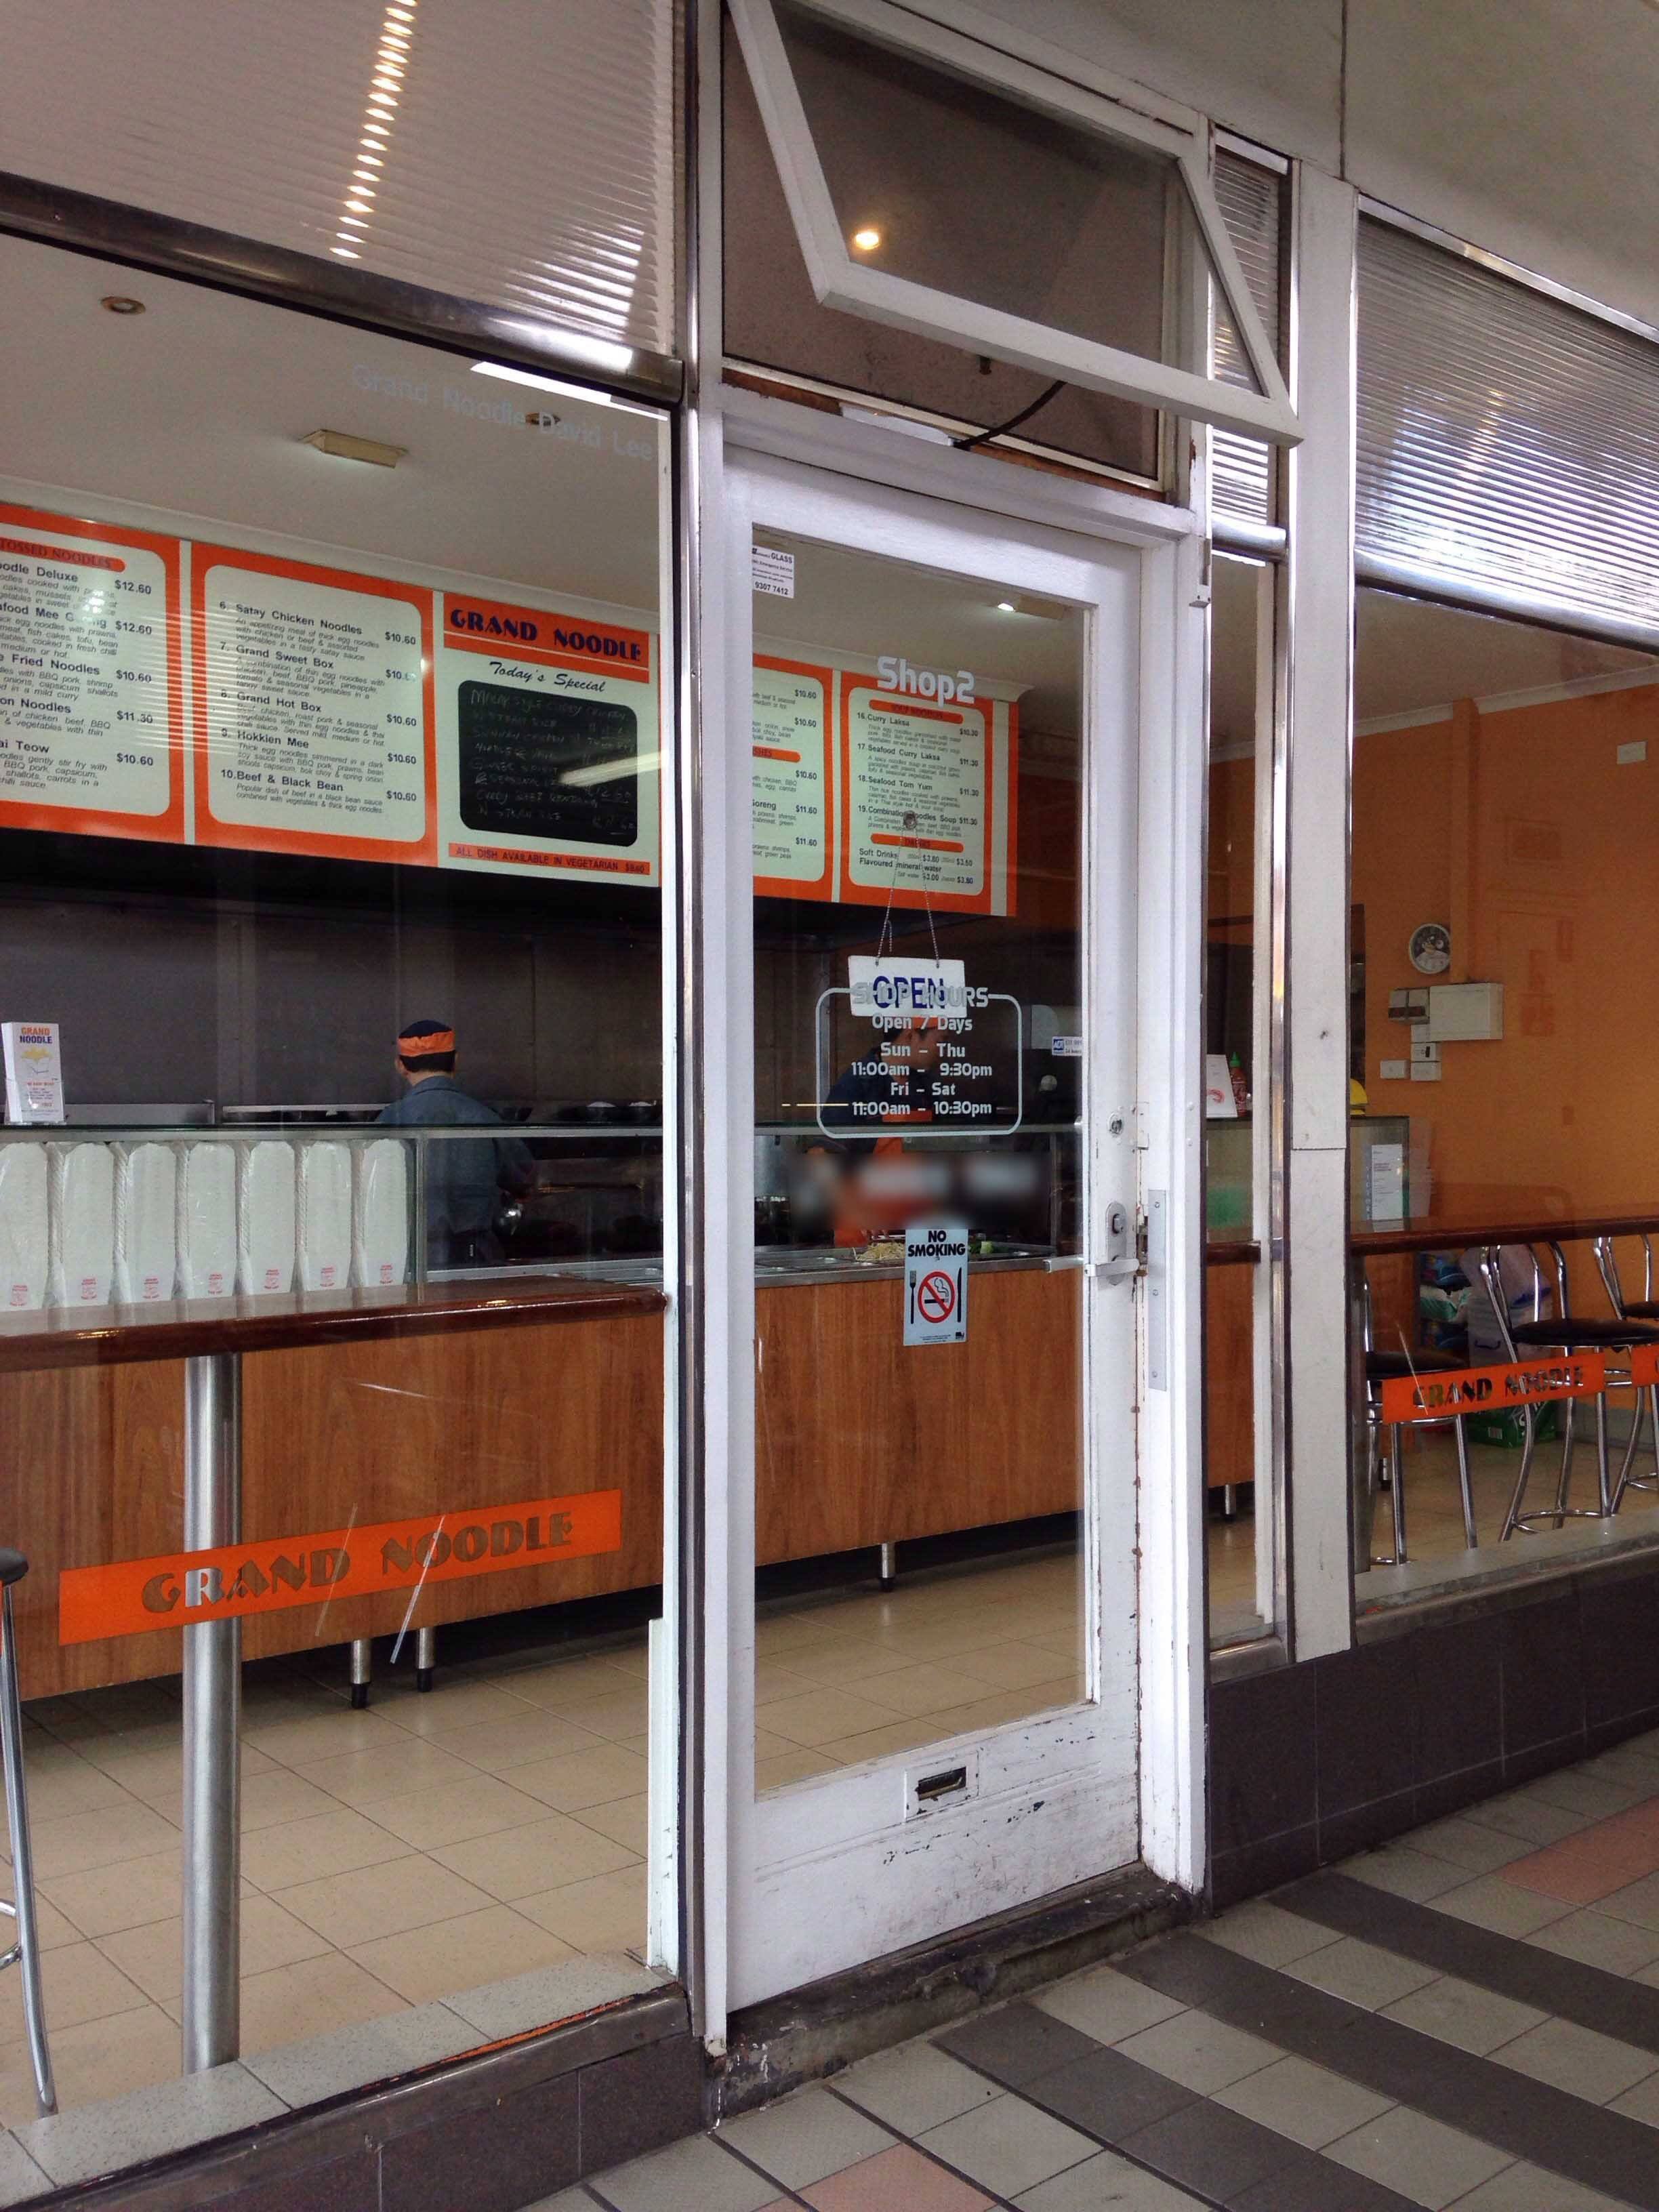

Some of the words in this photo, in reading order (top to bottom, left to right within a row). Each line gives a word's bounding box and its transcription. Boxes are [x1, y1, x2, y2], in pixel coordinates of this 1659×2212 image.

[613, 432, 653, 462] Lee
[53, 550, 111, 568] NOODLES
[37, 567, 79, 582] Deluxe
[115, 580, 152, 594] $12.60
[35, 607, 59, 619] Mee
[236, 603, 265, 619] Satay
[272, 610, 314, 626] Chicken
[321, 619, 363, 635] Noodles
[34, 622, 65, 631] noodles
[115, 621, 152, 635] $12.60
[385, 632, 416, 645] $10.60
[451, 609, 537, 642] GRAND
[554, 628, 640, 661] NOODLE
[236, 644, 269, 658] Grand
[276, 651, 307, 665] Sweet
[313, 657, 334, 669] Box
[12, 654, 43, 667] Fried
[51, 659, 101, 675] Noodles
[116, 670, 152, 683] $10.60
[489, 661, 546, 683] Today's
[554, 673, 606, 693] Special
[20, 698, 71, 714] Noodles
[237, 691, 270, 705] Grand
[276, 697, 295, 709] Hot
[301, 701, 322, 712] Box
[117, 710, 153, 724] $11.30
[386, 714, 417, 726] $10.60
[795, 717, 817, 728] $10.60
[890, 716, 910, 726] Laksa
[90, 720, 111, 730] BBQ
[237, 730, 281, 745] Hokkien
[287, 737, 309, 749] Mee
[16, 741, 49, 754] Teow
[868, 744, 895, 755] Seafood
[899, 749, 917, 759] Curry
[921, 752, 940, 761] Laksa
[117, 753, 154, 766] $10.60
[388, 753, 417, 764] $10.60
[796, 770, 817, 780] $10.60
[268, 775, 275, 784] &
[282, 777, 311, 788] Black
[316, 781, 344, 791] Bean
[918, 782, 933, 791] Yum
[386, 790, 417, 802] $10.60
[940, 815, 957, 824] Soup
[455, 846, 472, 857] ALL
[477, 848, 497, 860] DISH
[502, 851, 549, 865] AVAILABLE
[554, 856, 562, 865] IN
[567, 857, 619, 871] VEGETARIAN
[859, 848, 874, 857] Soft
[876, 850, 898, 859] Drinks
[859, 857, 893, 867] Flavoured
[896, 861, 921, 870] mineral
[924, 865, 942, 873] water
[873, 975, 945, 1008] OPEN
[922, 985, 989, 1008] HOURS
[872, 1012, 912, 1033] Open
[920, 1015, 929, 1030] 7
[937, 1015, 972, 1034] Days
[21, 1027, 50, 1036] GRAND
[20, 1035, 52, 1044] NOODLE
[880, 1042, 911, 1058] Sun
[937, 1042, 966, 1058] Thu
[851, 1062, 909, 1076] 11:00am
[940, 1063, 992, 1078] 9:30pm
[890, 1082, 909, 1096] Fri
[932, 1082, 956, 1096] Sat
[852, 1101, 910, 1116] 11:00am
[933, 1101, 992, 1116] 10:30pm
[928, 1230, 946, 1243] NO
[907, 1243, 966, 1257] SMOKING
[1413, 1378, 1492, 1408] GRAND
[141, 1547, 350, 1614] GRAND
[381, 1510, 572, 1575] NOODLE
